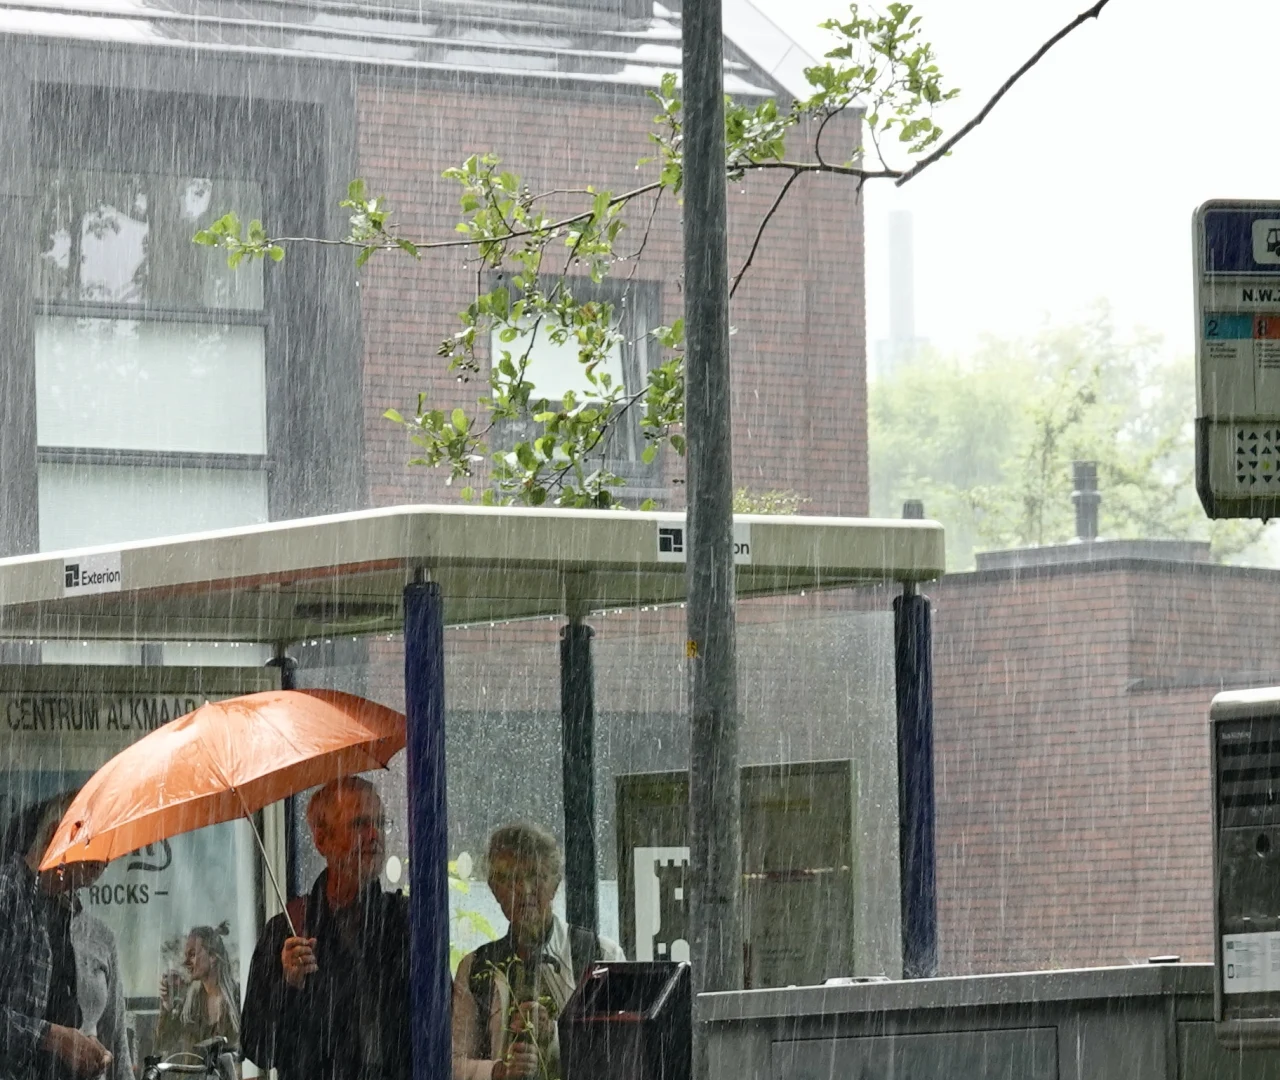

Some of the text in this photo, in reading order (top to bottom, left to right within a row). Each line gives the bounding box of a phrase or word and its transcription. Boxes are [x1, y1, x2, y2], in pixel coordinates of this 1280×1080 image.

[1207, 320, 1219, 337] 2
[81, 568, 120, 586] Exterion
[7, 698, 100, 731] CENTRUM
[89, 884, 149, 905] ROCKS
